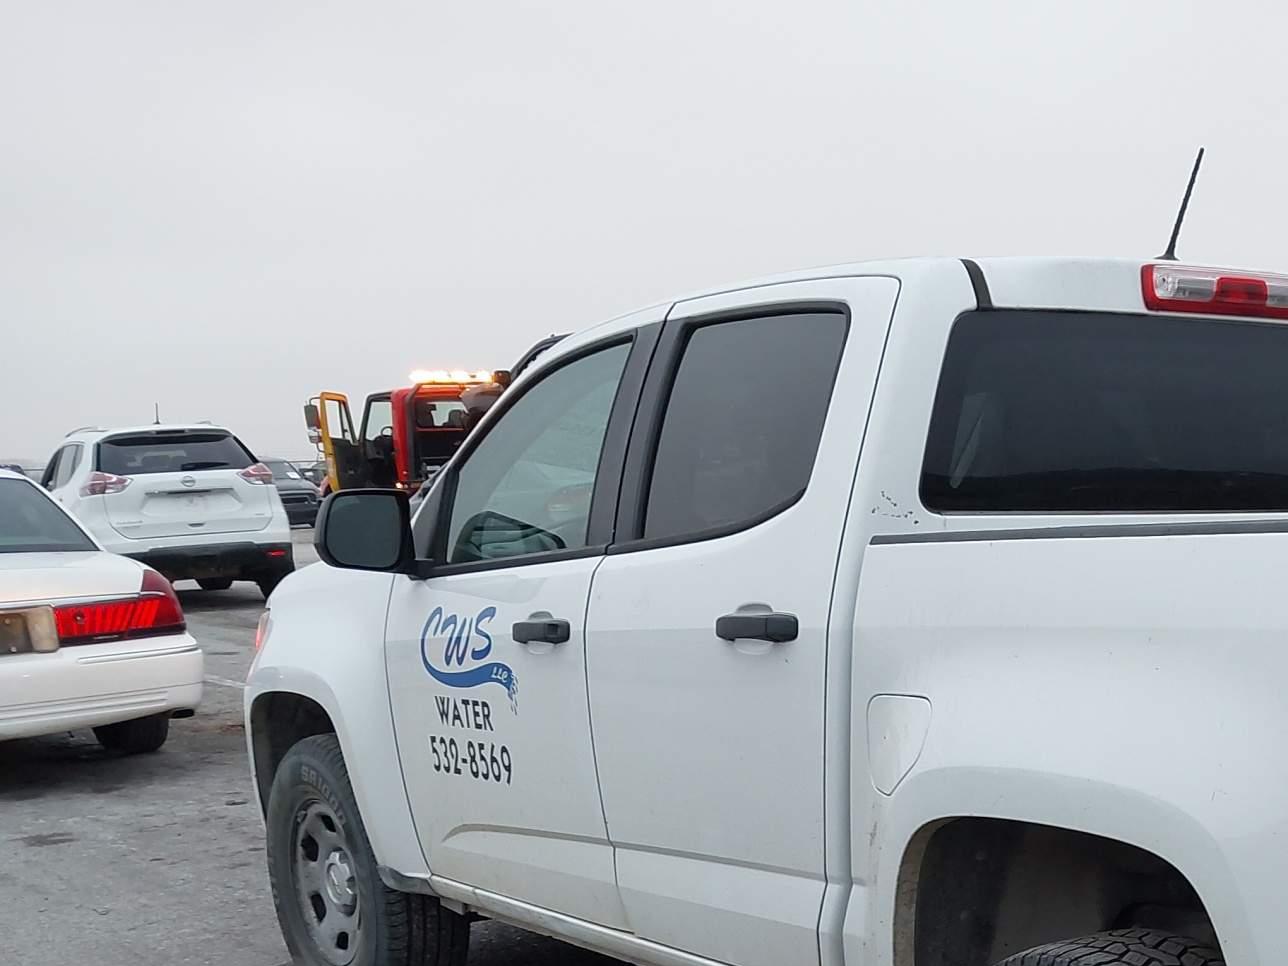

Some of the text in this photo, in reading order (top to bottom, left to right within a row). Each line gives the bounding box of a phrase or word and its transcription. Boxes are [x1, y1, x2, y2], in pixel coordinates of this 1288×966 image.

[420, 606, 497, 676] CWS
[434, 695, 494, 731] WATER
[429, 735, 512, 786] 532-8569
